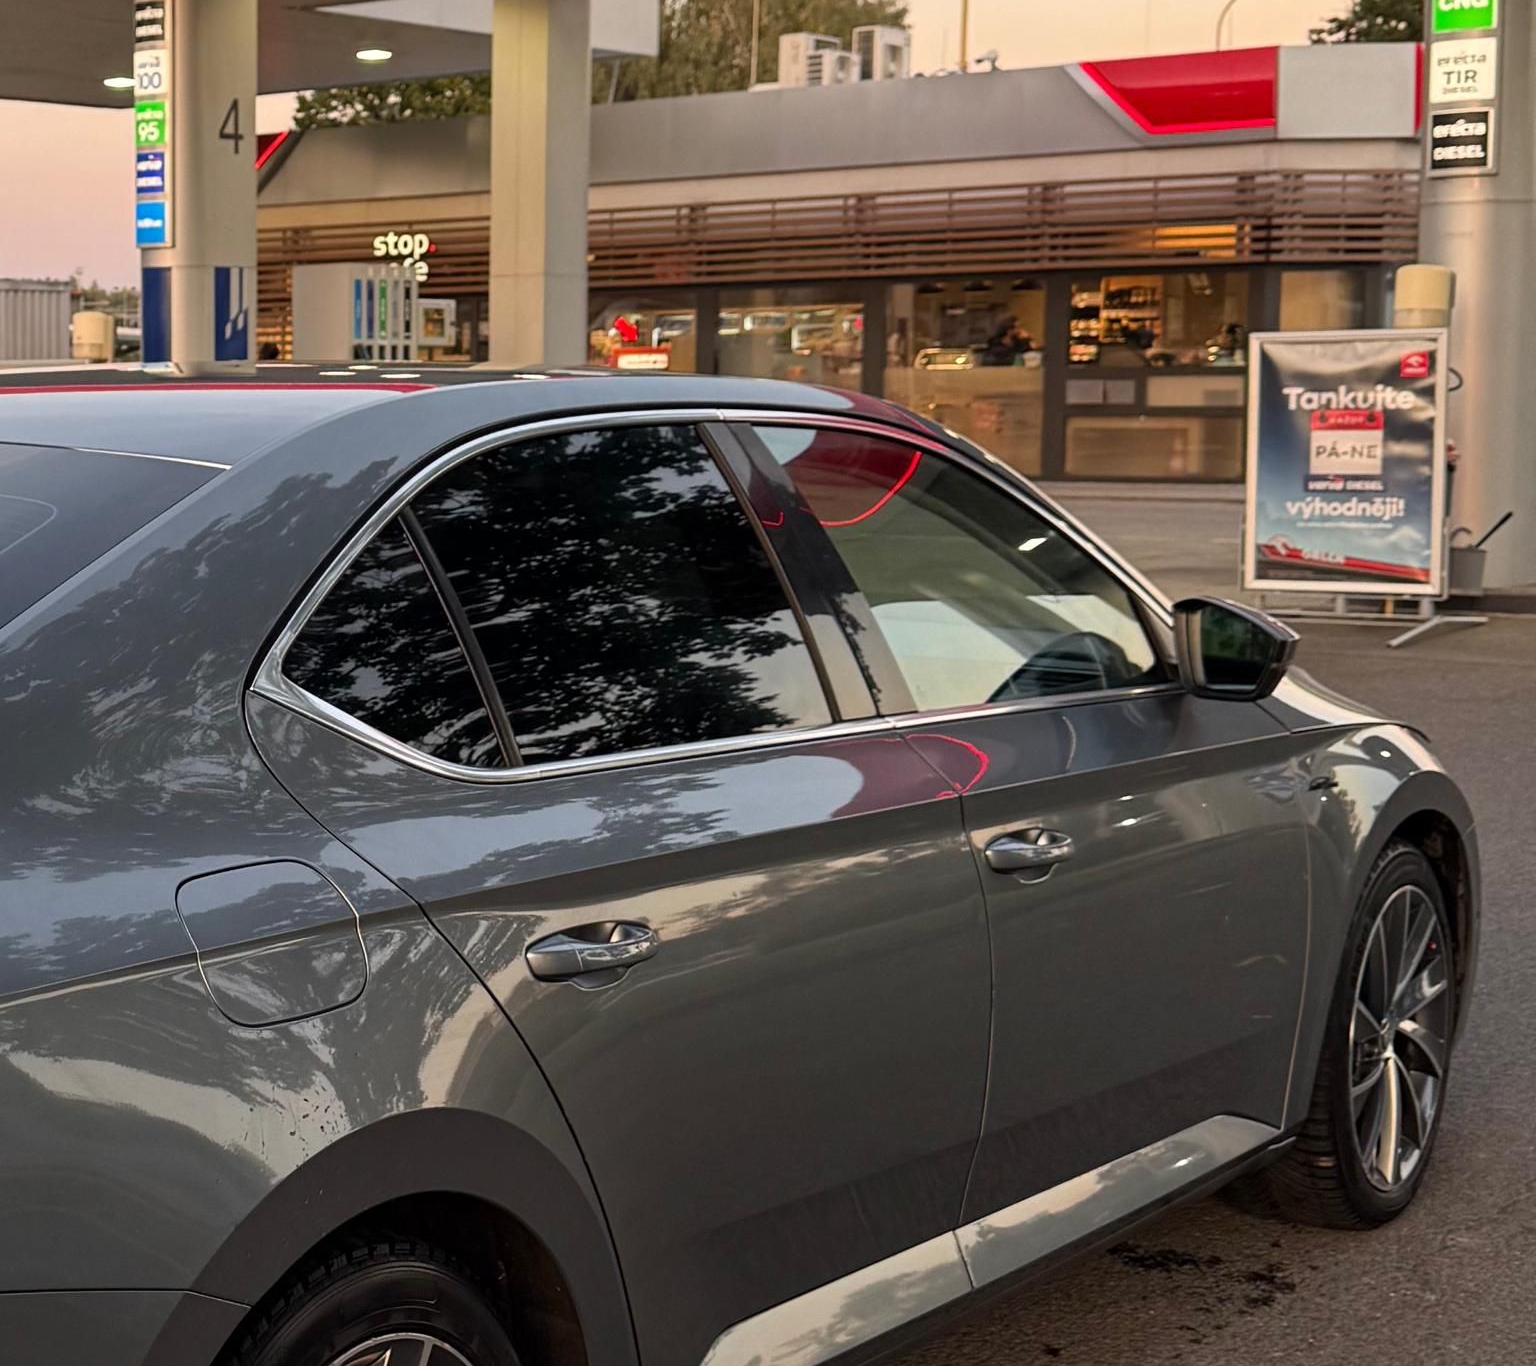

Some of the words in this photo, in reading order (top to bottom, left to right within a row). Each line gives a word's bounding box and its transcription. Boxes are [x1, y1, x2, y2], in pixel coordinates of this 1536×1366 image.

[137, 71, 162, 90] 100
[1442, 69, 1478, 86] TIR
[138, 121, 161, 143] 95
[218, 97, 245, 155] 4
[1282, 383, 1417, 412] Tankujte
[1314, 440, 1379, 460] PÁ-NE
[1285, 496, 1406, 521] výhodněji!
